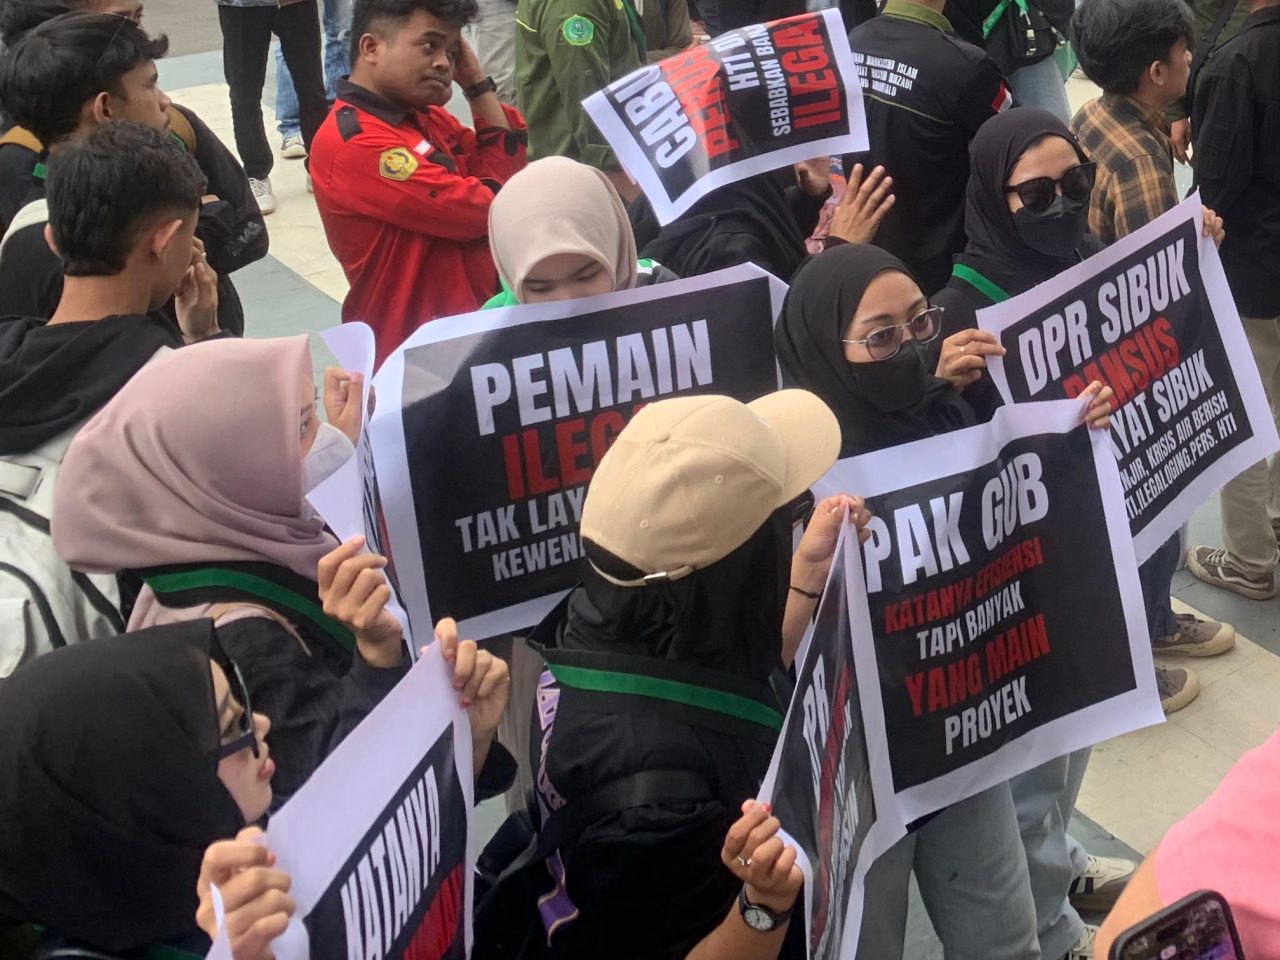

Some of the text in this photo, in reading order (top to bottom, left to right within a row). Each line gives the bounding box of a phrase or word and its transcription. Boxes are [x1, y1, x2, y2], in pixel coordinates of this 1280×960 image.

[608, 64, 697, 168] CABU
[721, 52, 760, 91] HTI
[760, 58, 792, 137] SEBABKAN
[769, 15, 841, 129] ILEGA
[896, 62, 918, 80] ISLAM
[1018, 238, 1192, 396] DPR SIBUK
[470, 319, 713, 436] PEMAIN
[1152, 348, 1215, 423] SIBUK
[503, 407, 632, 501] ILEG
[1120, 390, 1229, 492] NJIR, KRISIS AIR BERISH
[1216, 412, 1238, 440] HTI
[455, 486, 586, 553] TAK LAY
[492, 533, 586, 582] KEWEN
[863, 452, 1049, 593] PAK GUB
[883, 536, 1044, 635] KATANYA EFISIENSI
[916, 580, 1026, 661] TAPI BANYAK
[903, 614, 1051, 717] YANG MAIN
[944, 675, 1032, 756] PROYEK
[340, 764, 440, 960] KATANYA
